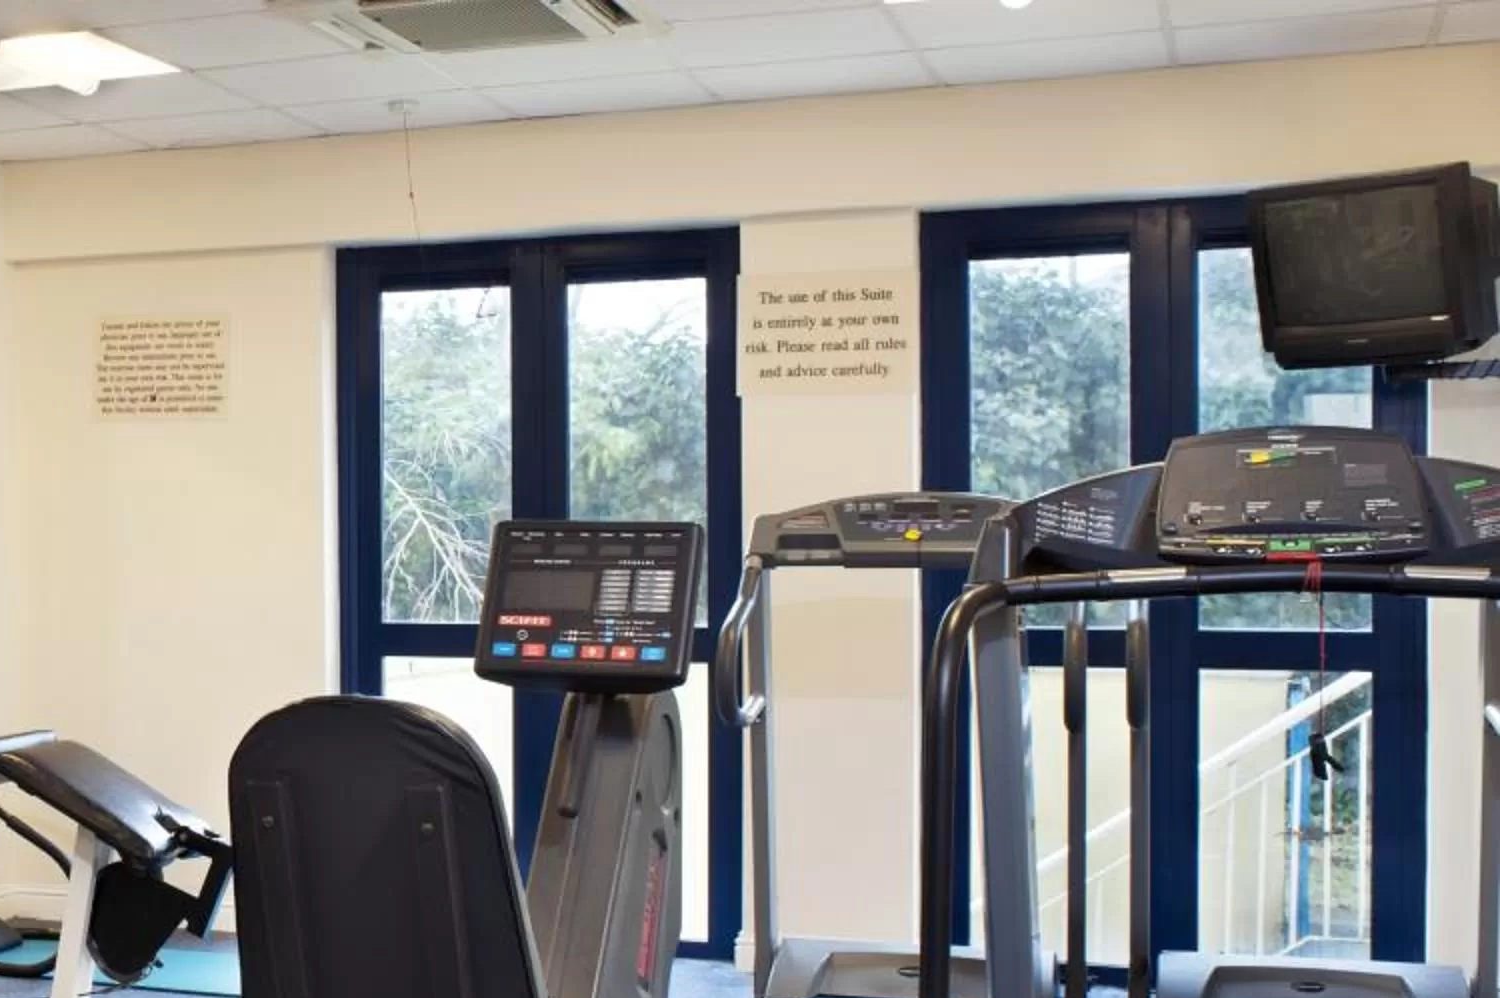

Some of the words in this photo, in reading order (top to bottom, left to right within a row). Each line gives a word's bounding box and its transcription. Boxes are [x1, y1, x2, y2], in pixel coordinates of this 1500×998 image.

[759, 290, 783, 304] The
[813, 290, 827, 304] of
[832, 288, 856, 301] this
[860, 287, 893, 301] Suite
[752, 318, 763, 329] is
[767, 314, 816, 331] entirely
[820, 316, 834, 327] at
[837, 315, 867, 330] your
[872, 313, 900, 325] own
[776, 339, 816, 353] Please
[821, 339, 849, 352] read
[853, 338, 870, 351] all
[875, 337, 908, 350] rules
[759, 364, 782, 379] and
[786, 362, 828, 377] advice
